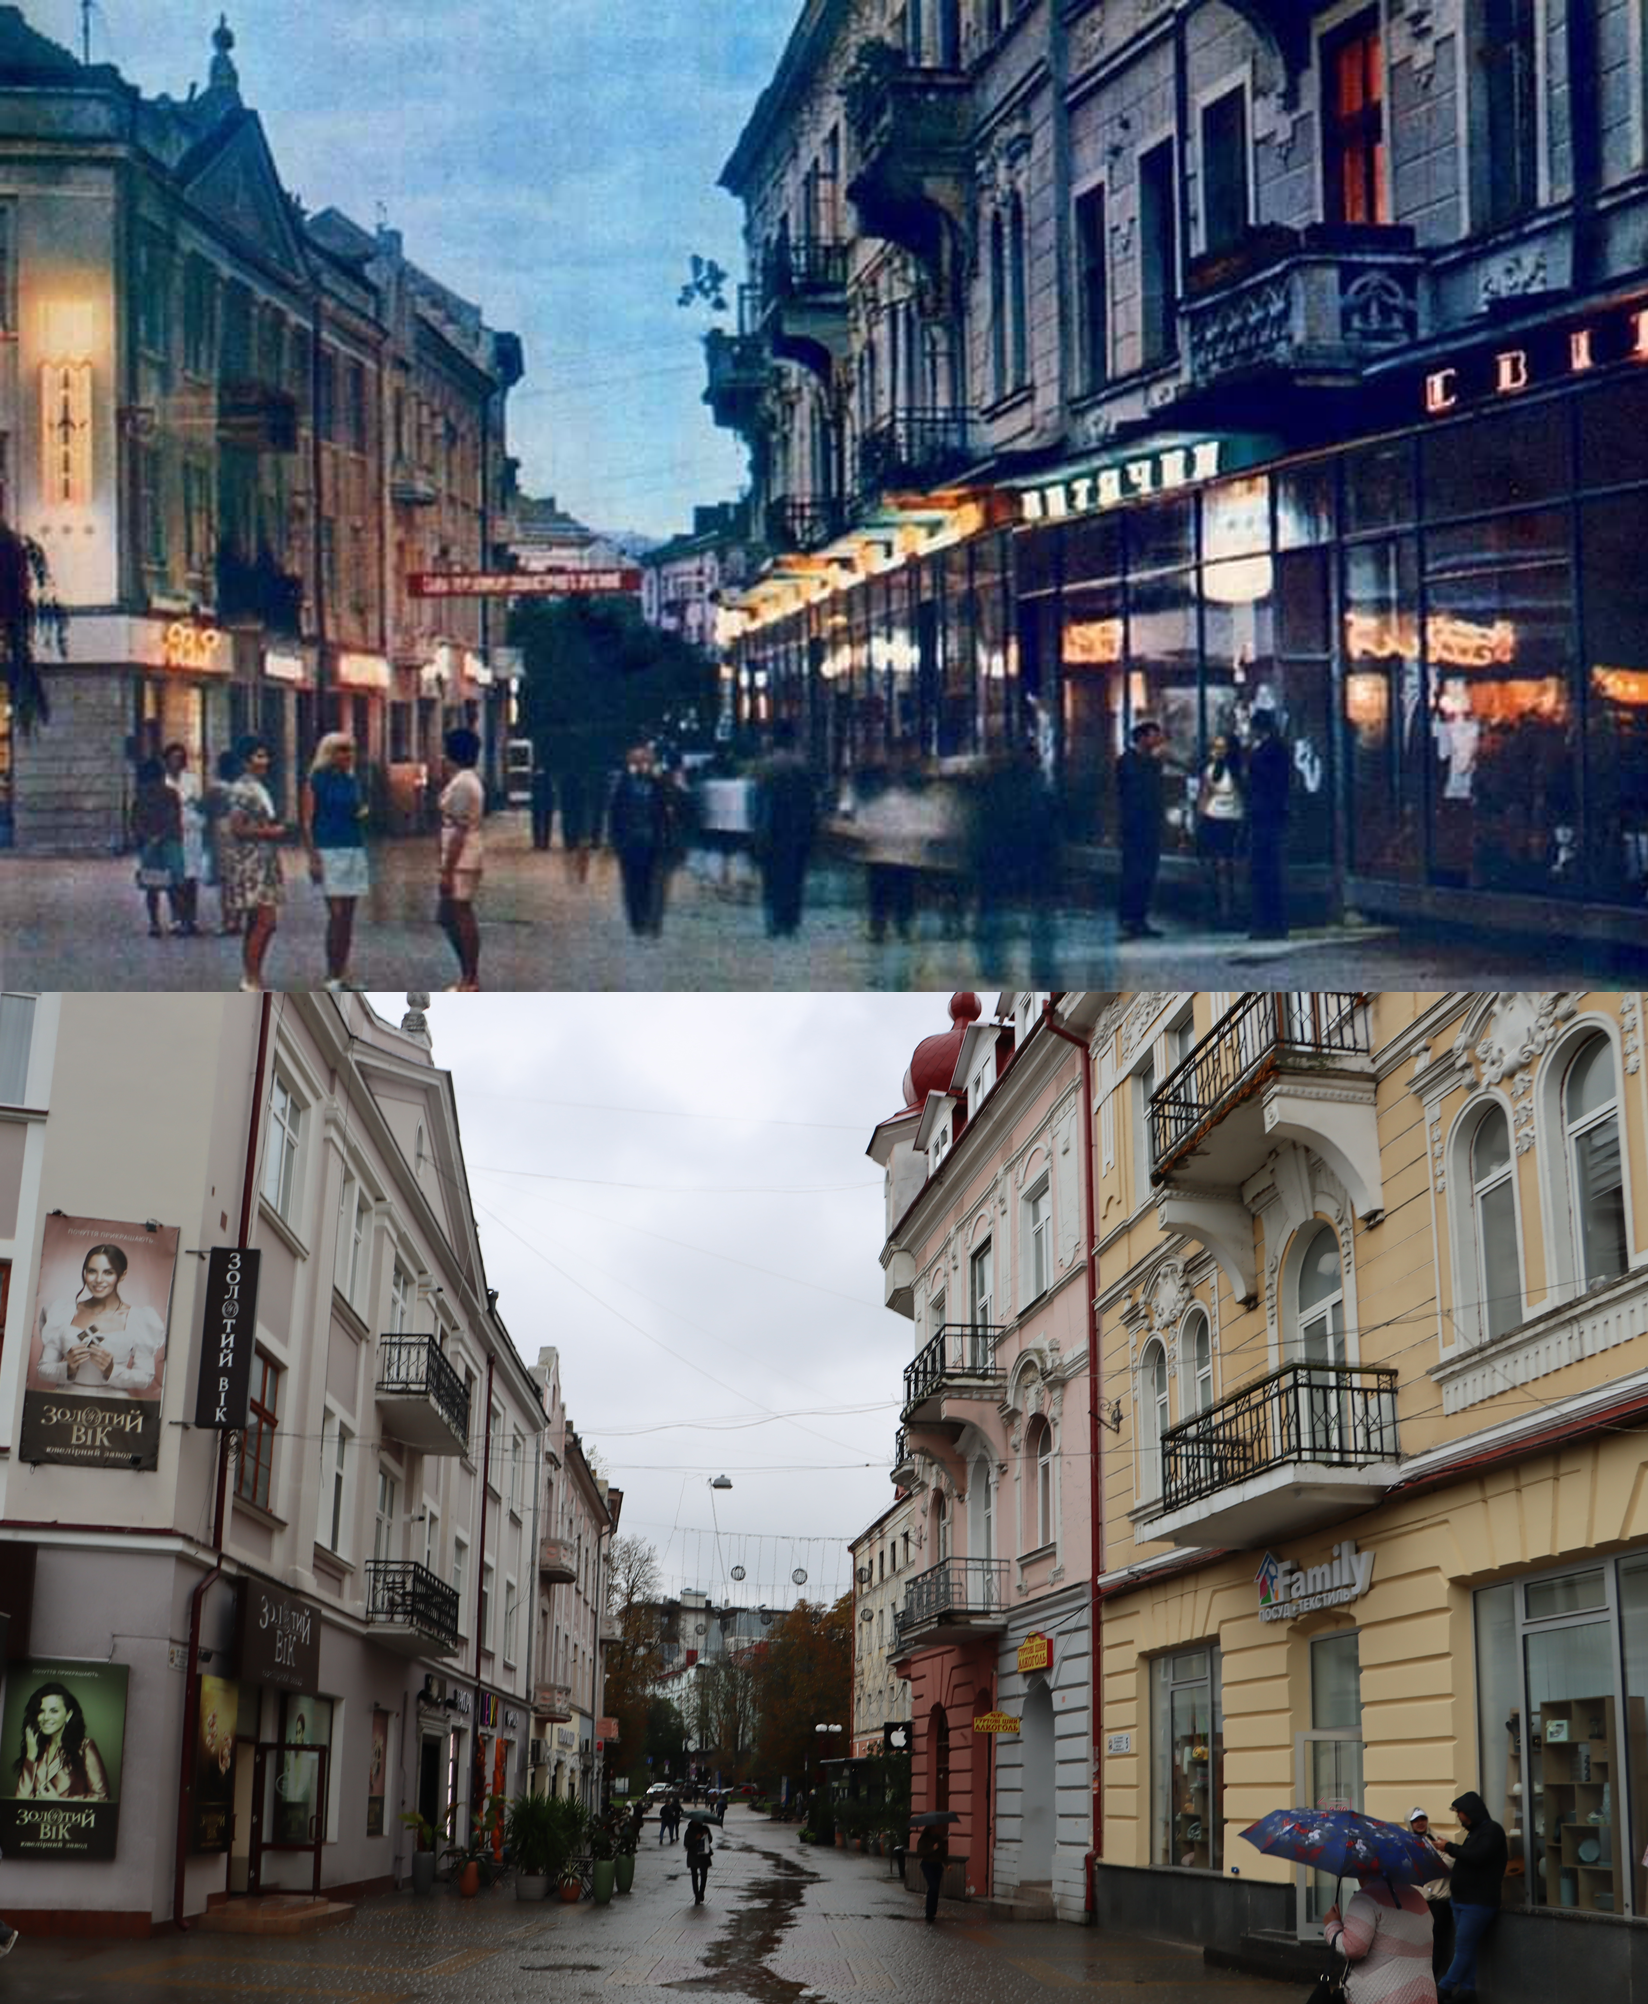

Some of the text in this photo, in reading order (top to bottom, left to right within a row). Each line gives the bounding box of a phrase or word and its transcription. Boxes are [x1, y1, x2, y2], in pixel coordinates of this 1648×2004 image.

[67, 1227, 99, 1238] ПОЧУТТЯ
[218, 1252, 242, 1368] ЗОЛОТИЙ
[214, 1377, 230, 1423] ВІК
[70, 1424, 113, 1448] ВІК
[45, 1445, 102, 1458] ювелірний
[1277, 1539, 1376, 1602] Family
[1258, 1587, 1352, 1622] ПОСУД ТЕКСТИЛЬ
[274, 1629, 297, 1668] ВІК
[1018, 1652, 1047, 1670] АЛКОГОЛЬ
[975, 1724, 1019, 1732] АЛКОГОЛЬ
[39, 1823, 72, 1840] ВІК
[20, 1840, 88, 1850] ювелірний завод
